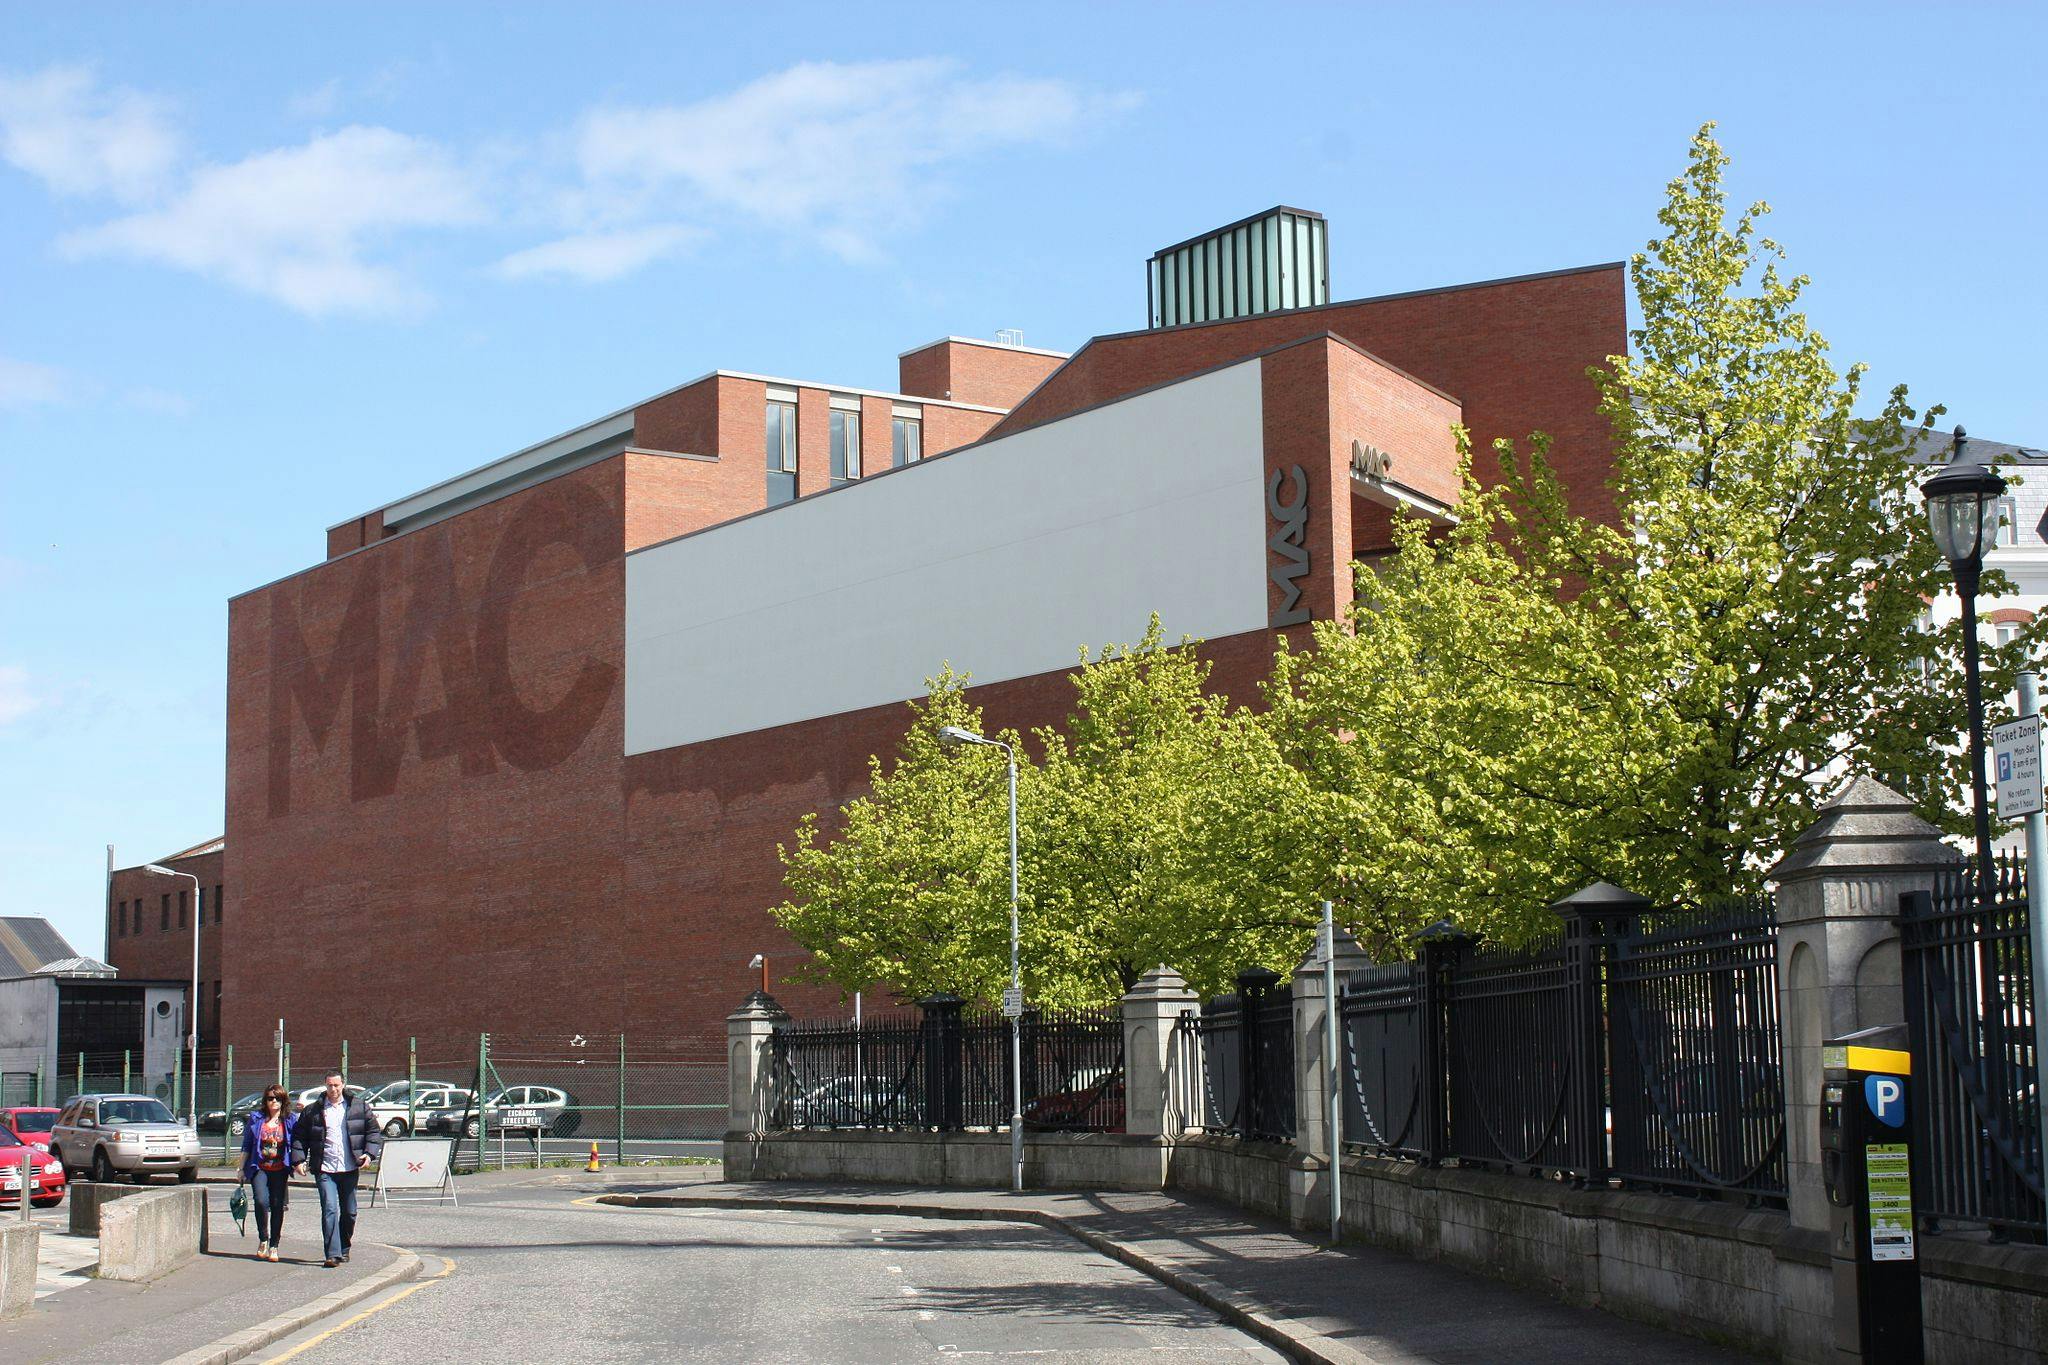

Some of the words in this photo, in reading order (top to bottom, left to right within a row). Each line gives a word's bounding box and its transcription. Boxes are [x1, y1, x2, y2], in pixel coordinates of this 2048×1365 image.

[1352, 439, 1392, 482] MAC
[1268, 463, 1310, 627] MAC
[268, 478, 624, 819] MAC
[1995, 728, 2017, 744] Ticket
[2018, 725, 2037, 739] Zone
[2013, 745, 2035, 756] Mon-Sat
[2008, 790, 2015, 799] No
[2015, 787, 2031, 797] return
[2023, 799, 2034, 808] hour
[1877, 1080, 1899, 1116] P
